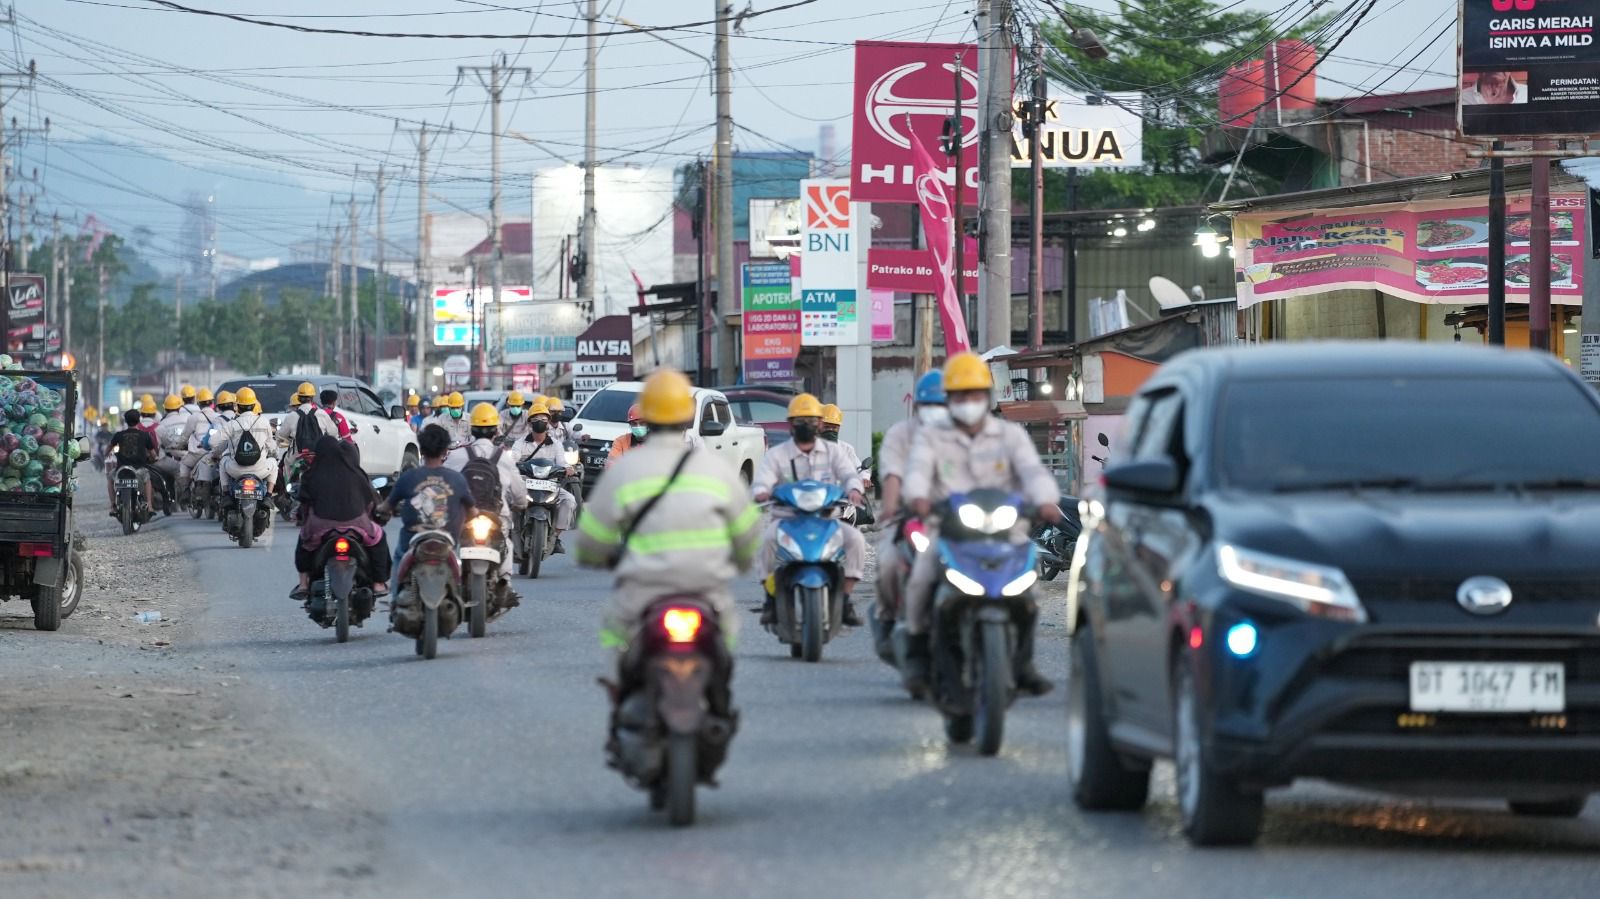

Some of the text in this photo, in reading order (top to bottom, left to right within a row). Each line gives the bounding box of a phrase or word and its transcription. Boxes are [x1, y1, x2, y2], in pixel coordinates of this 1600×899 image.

[1489, 16, 1593, 31] GARIS MERAH
[1489, 34, 1593, 49] ISINYA A MILD
[1550, 78, 1598, 86] PERINGATAN:
[808, 233, 850, 252] BNI
[871, 265, 913, 275] Patrako
[752, 293, 792, 304] APOTEK
[805, 292, 836, 303] ATM
[577, 341, 632, 356] ALYSA
[581, 364, 608, 373] CAFE
